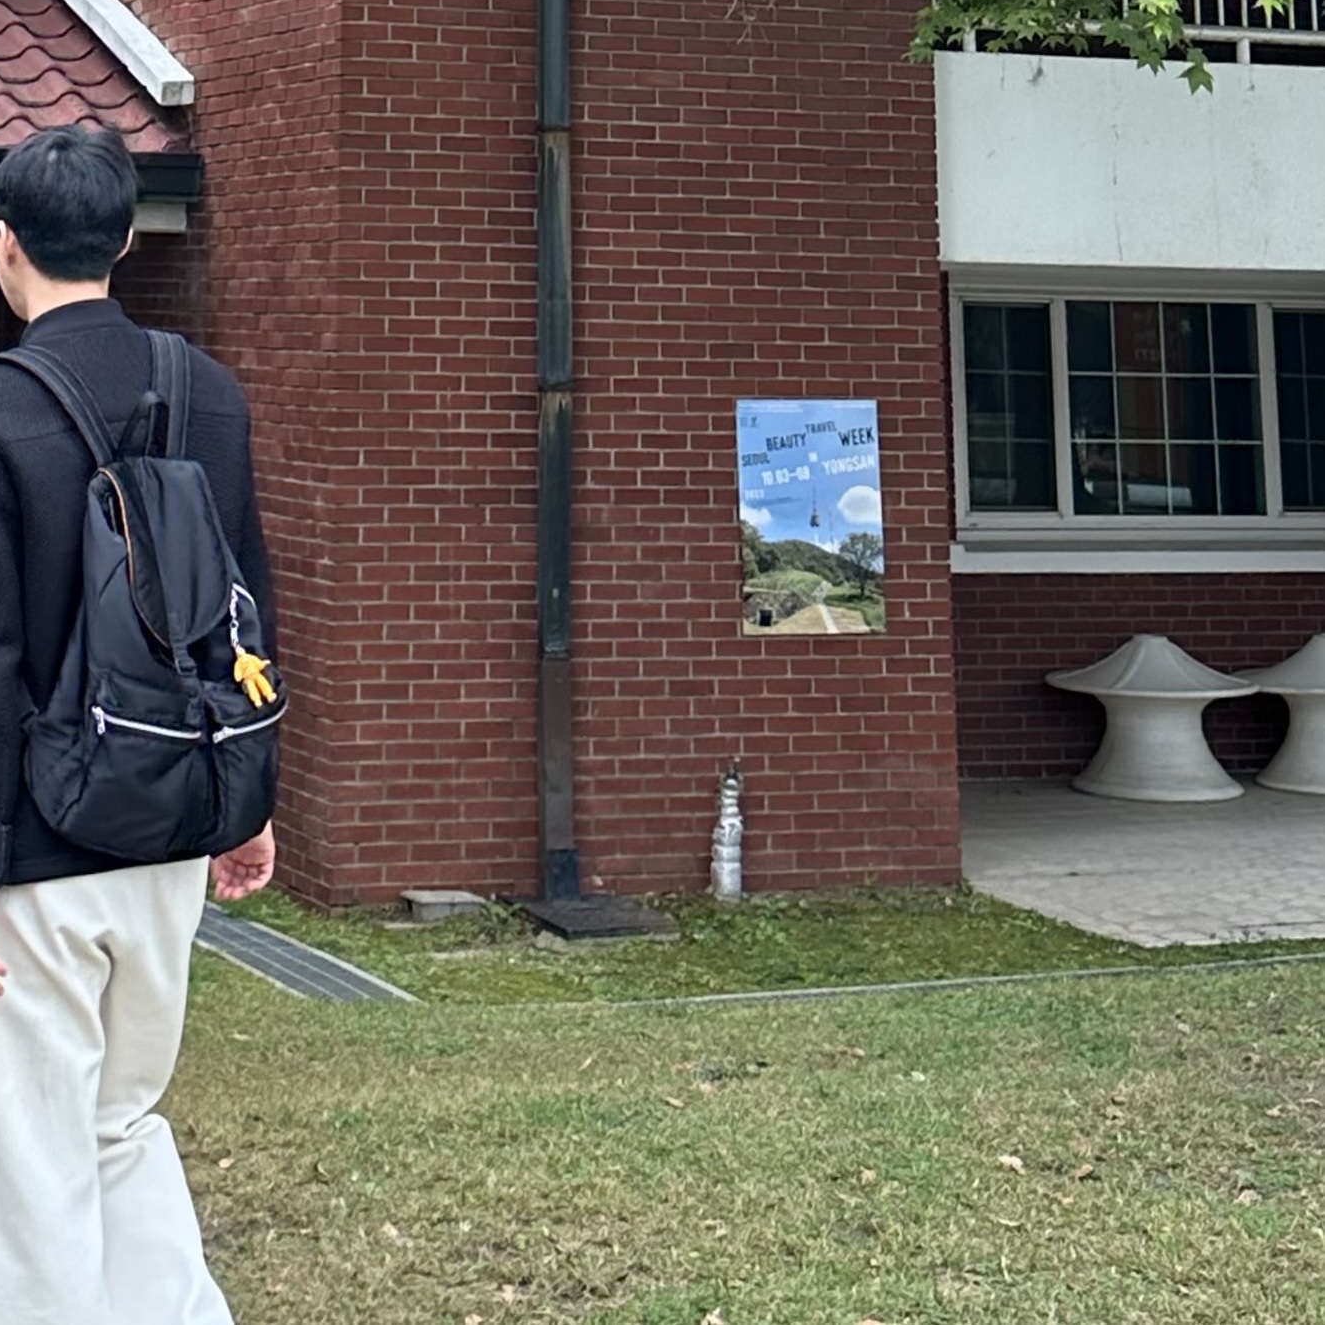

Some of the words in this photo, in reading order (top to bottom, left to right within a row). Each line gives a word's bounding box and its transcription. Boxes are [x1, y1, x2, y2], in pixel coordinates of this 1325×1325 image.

[766, 433, 806, 451] BEAUTY
[805, 421, 837, 434] TRAVEL
[838, 427, 875, 446] WEEK
[822, 455, 875, 475] YONGSAN
